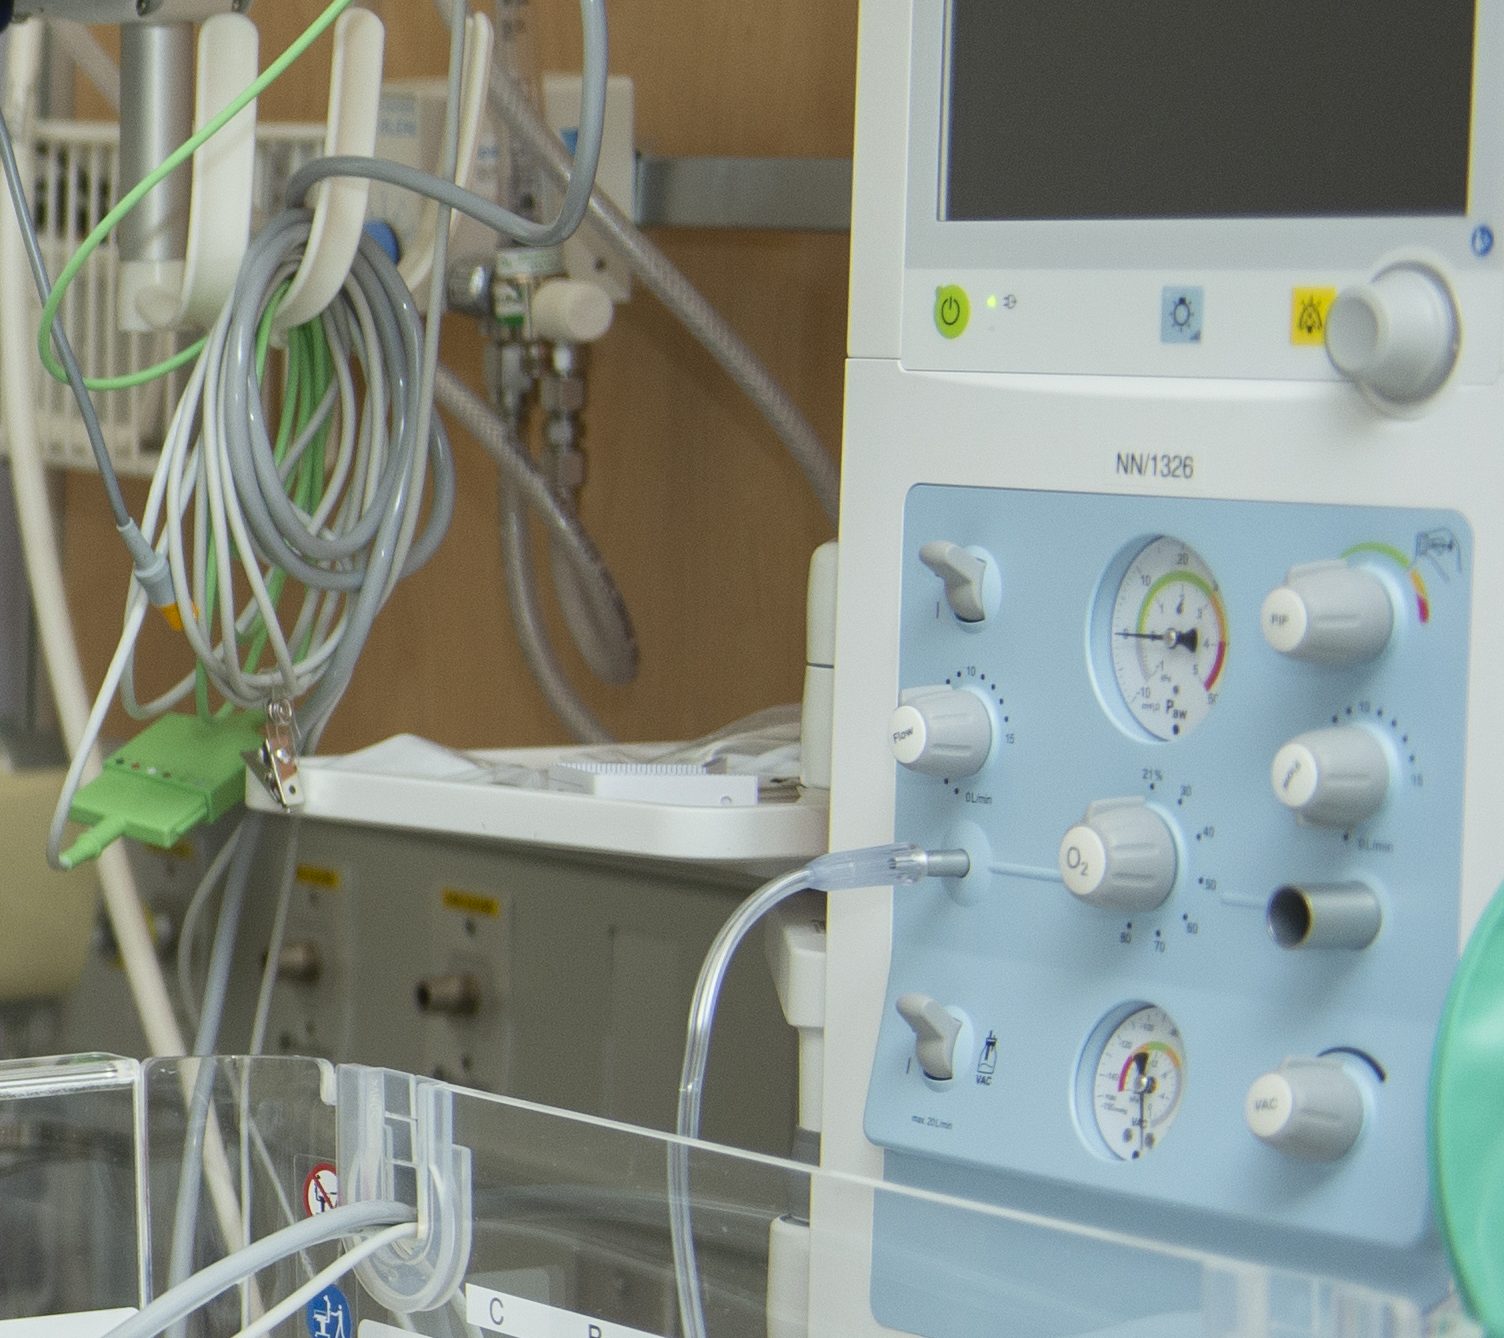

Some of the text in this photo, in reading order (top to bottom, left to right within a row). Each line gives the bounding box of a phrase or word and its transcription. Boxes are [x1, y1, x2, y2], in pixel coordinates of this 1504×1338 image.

[1115, 452, 1194, 479] NN/1326
[1140, 575, 1152, 587] 10
[966, 665, 977, 677] 10
[893, 727, 914, 744] Flow
[1005, 732, 1015, 745] 15
[1141, 767, 1164, 782] 21%
[1180, 784, 1193, 797] 30
[1203, 825, 1215, 838] 40
[1204, 878, 1217, 891] 50
[1186, 922, 1199, 935] 60
[1154, 940, 1166, 953] 70
[975, 1074, 993, 1086] VAC
[1253, 1097, 1278, 1111] VAC
[489, 1297, 505, 1326] C
